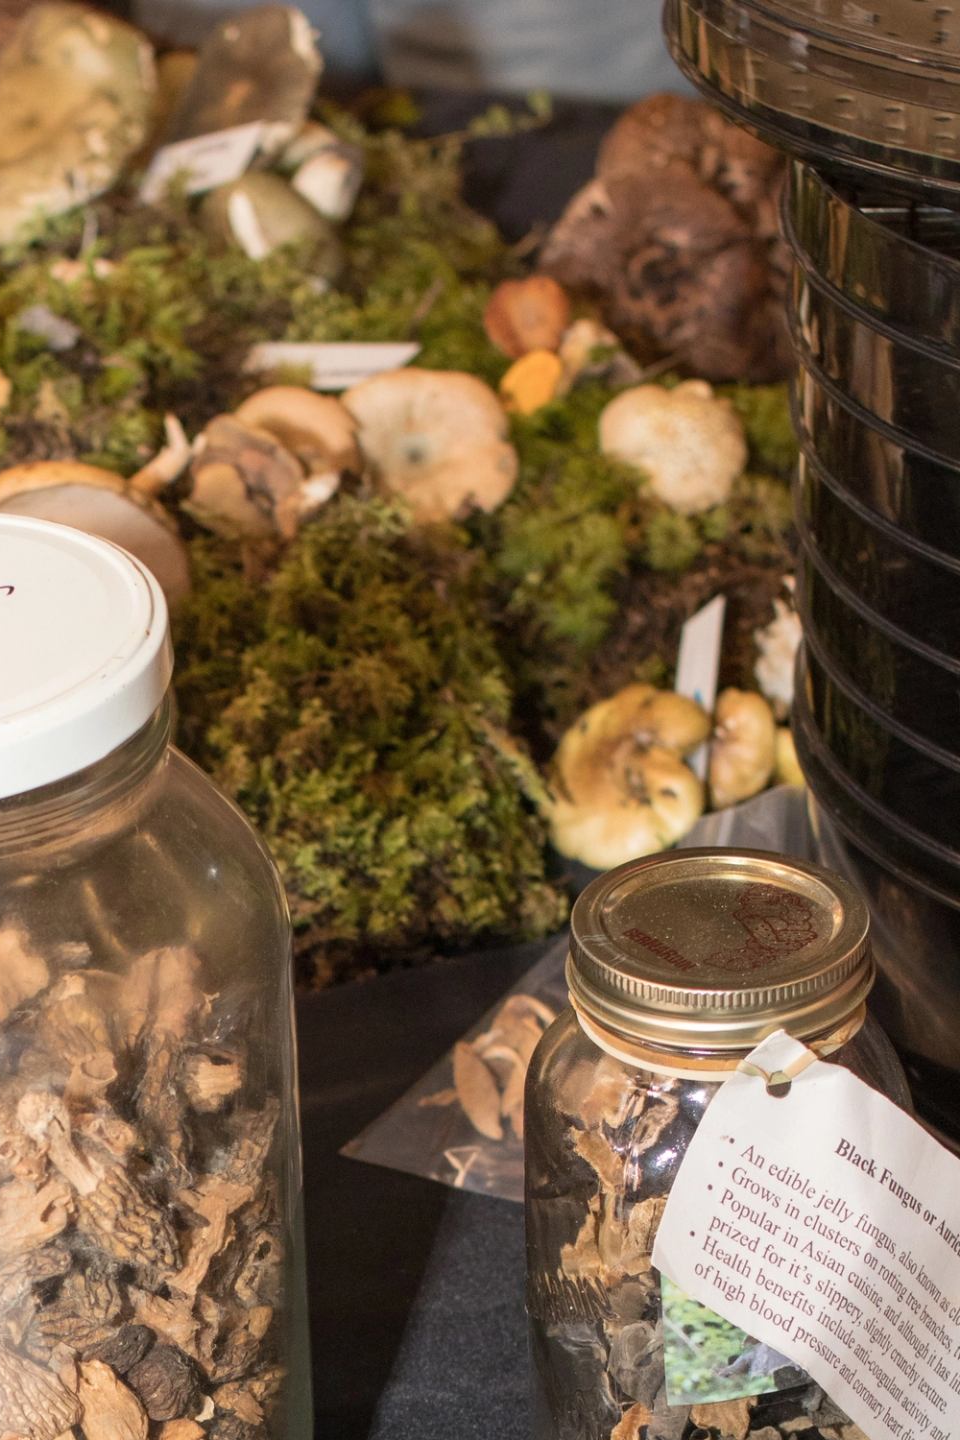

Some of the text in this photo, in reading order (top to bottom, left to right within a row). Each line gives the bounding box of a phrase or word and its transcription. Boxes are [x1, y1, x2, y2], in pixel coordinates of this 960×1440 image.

[731, 1167, 781, 1209] Grows
[784, 1198, 800, 1220] in
[803, 1213, 862, 1257] clusters
[864, 1251, 879, 1271] on
[878, 1264, 908, 1302] rotting
[905, 1290, 921, 1315] tree
[919, 1305, 952, 1353] branches,
[741, 1145, 765, 1169] An
[768, 1164, 816, 1199] edible
[813, 1190, 854, 1224] jelly
[856, 1214, 897, 1258] fungus,
[898, 1251, 917, 1275] also
[916, 1265, 942, 1303] known
[940, 1297, 950, 1313] as
[834, 1138, 877, 1178] Black
[879, 1168, 922, 1214] Fungus
[924, 1210, 937, 1226] or
[694, 1261, 713, 1281] of
[713, 1270, 746, 1304] high
[749, 1294, 794, 1332] blood
[792, 1326, 841, 1370] pressure
[839, 1362, 856, 1385] and
[852, 1378, 885, 1420] coronary
[882, 1407, 902, 1438] heart
[701, 1235, 751, 1278] Health
[755, 1268, 815, 1317] benefits
[817, 1306, 856, 1349] include
[854, 1343, 904, 1403] anti-coagulant
[901, 1397, 932, 1433] activity
[709, 1215, 760, 1253] prized
[762, 1244, 786, 1268] for
[815, 1276, 864, 1327] slippery,
[863, 1318, 892, 1356] slightly
[890, 1348, 920, 1387] crunchy
[917, 1378, 947, 1414] texture.
[720, 1189, 781, 1236] Popular
[783, 1227, 799, 1248] in
[800, 1241, 848, 1277] Asian
[847, 1271, 883, 1313] cuisine,
[883, 1305, 901, 1326] and
[898, 1320, 930, 1361] although
[927, 1350, 937, 1368] it
[935, 1357, 950, 1382] has
